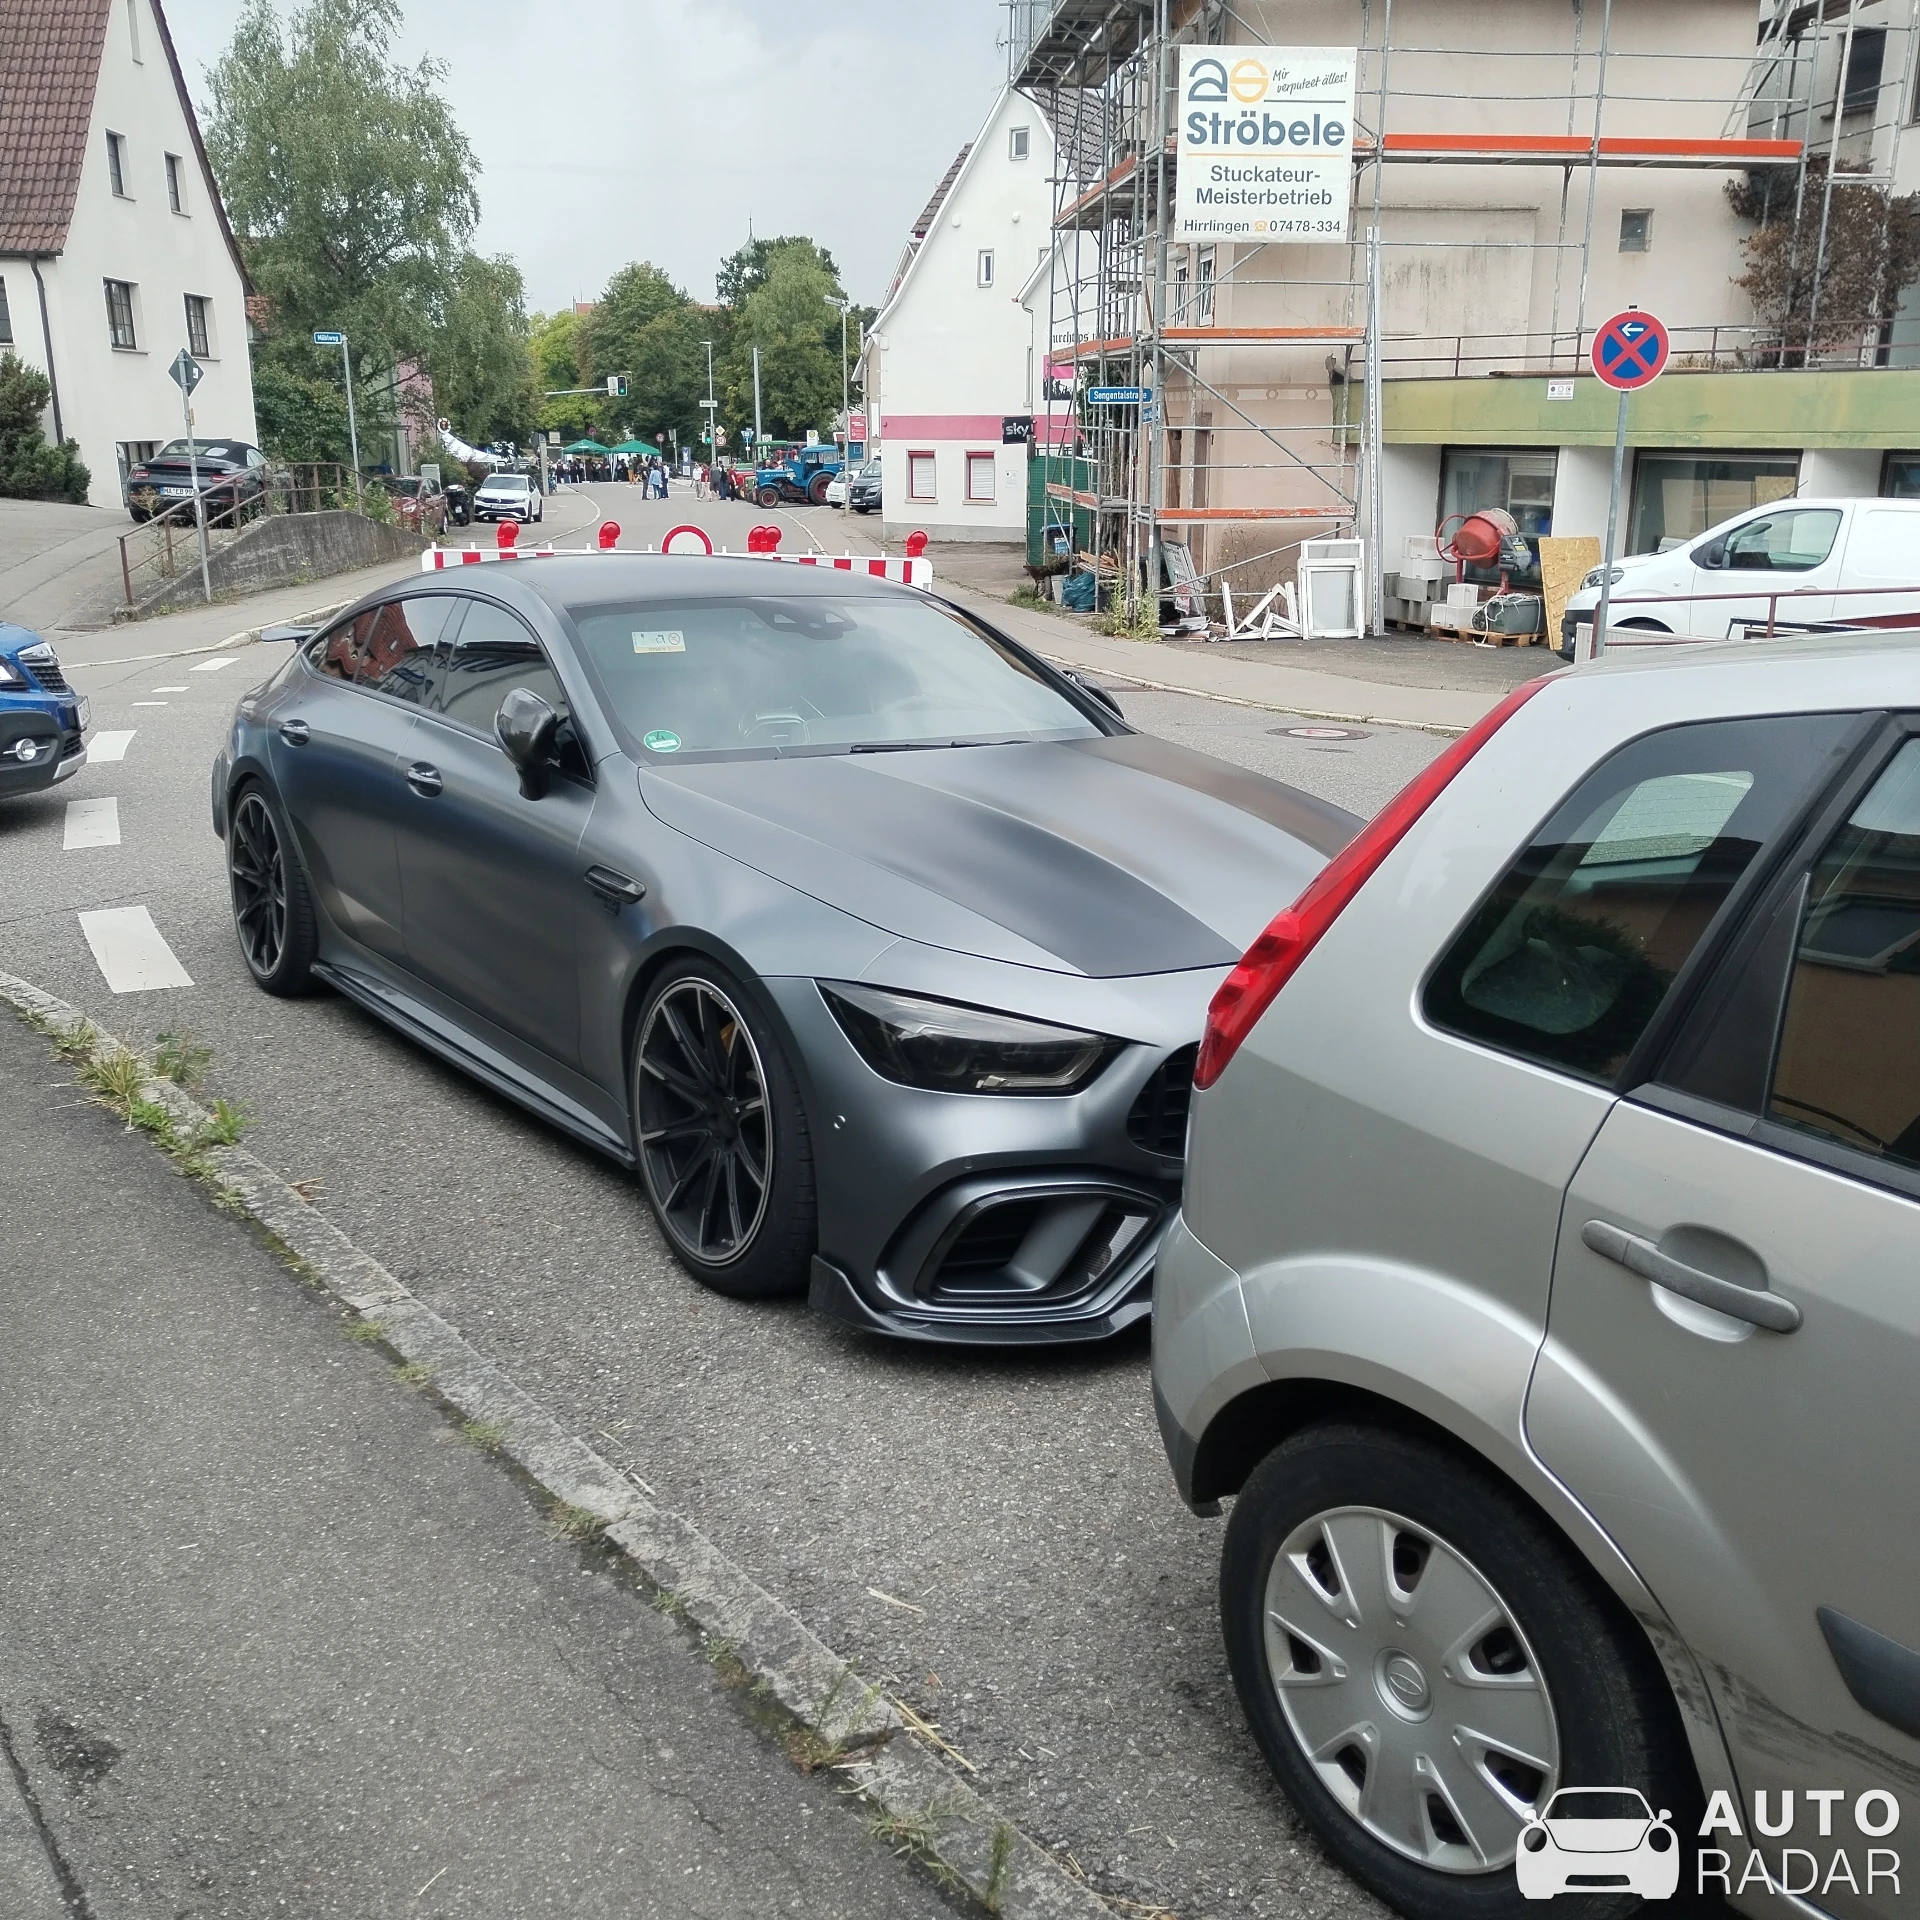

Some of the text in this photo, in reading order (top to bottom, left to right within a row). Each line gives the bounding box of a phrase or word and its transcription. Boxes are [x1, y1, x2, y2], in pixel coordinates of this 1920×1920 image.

[1272, 67, 1290, 81] Mir
[1186, 110, 1346, 146] Ströbele
[1210, 165, 1321, 183] Stuckateur-
[1196, 187, 1333, 205] Meisterbetrieb
[1184, 219, 1341, 235] Hirrlingen 07478-334
[1093, 390, 1147, 401] Sengentalstrae
[1005, 422, 1030, 438] sky
